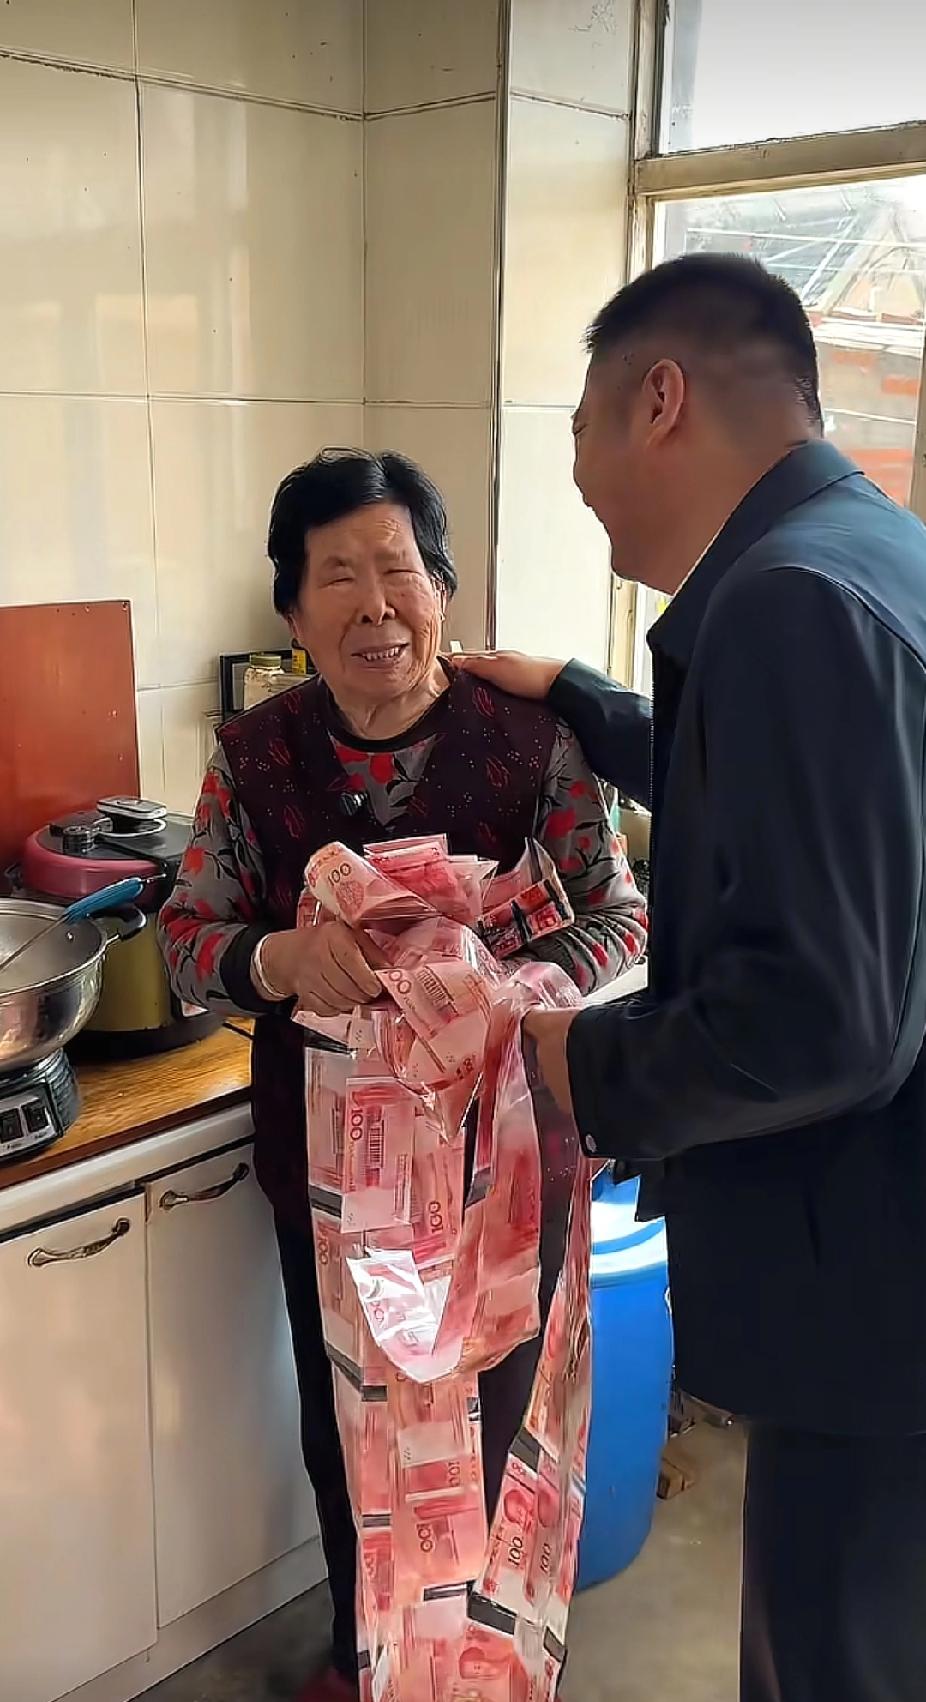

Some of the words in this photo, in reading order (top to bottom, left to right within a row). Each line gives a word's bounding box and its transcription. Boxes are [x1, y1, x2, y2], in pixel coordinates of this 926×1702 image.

[327, 863, 351, 887] 100
[388, 970, 411, 994] 00
[350, 1109, 363, 1141] 100
[429, 1201, 443, 1234] 100
[416, 1523, 433, 1553] 100
[508, 1536, 523, 1566] 100
[540, 1542, 551, 1574] 100
